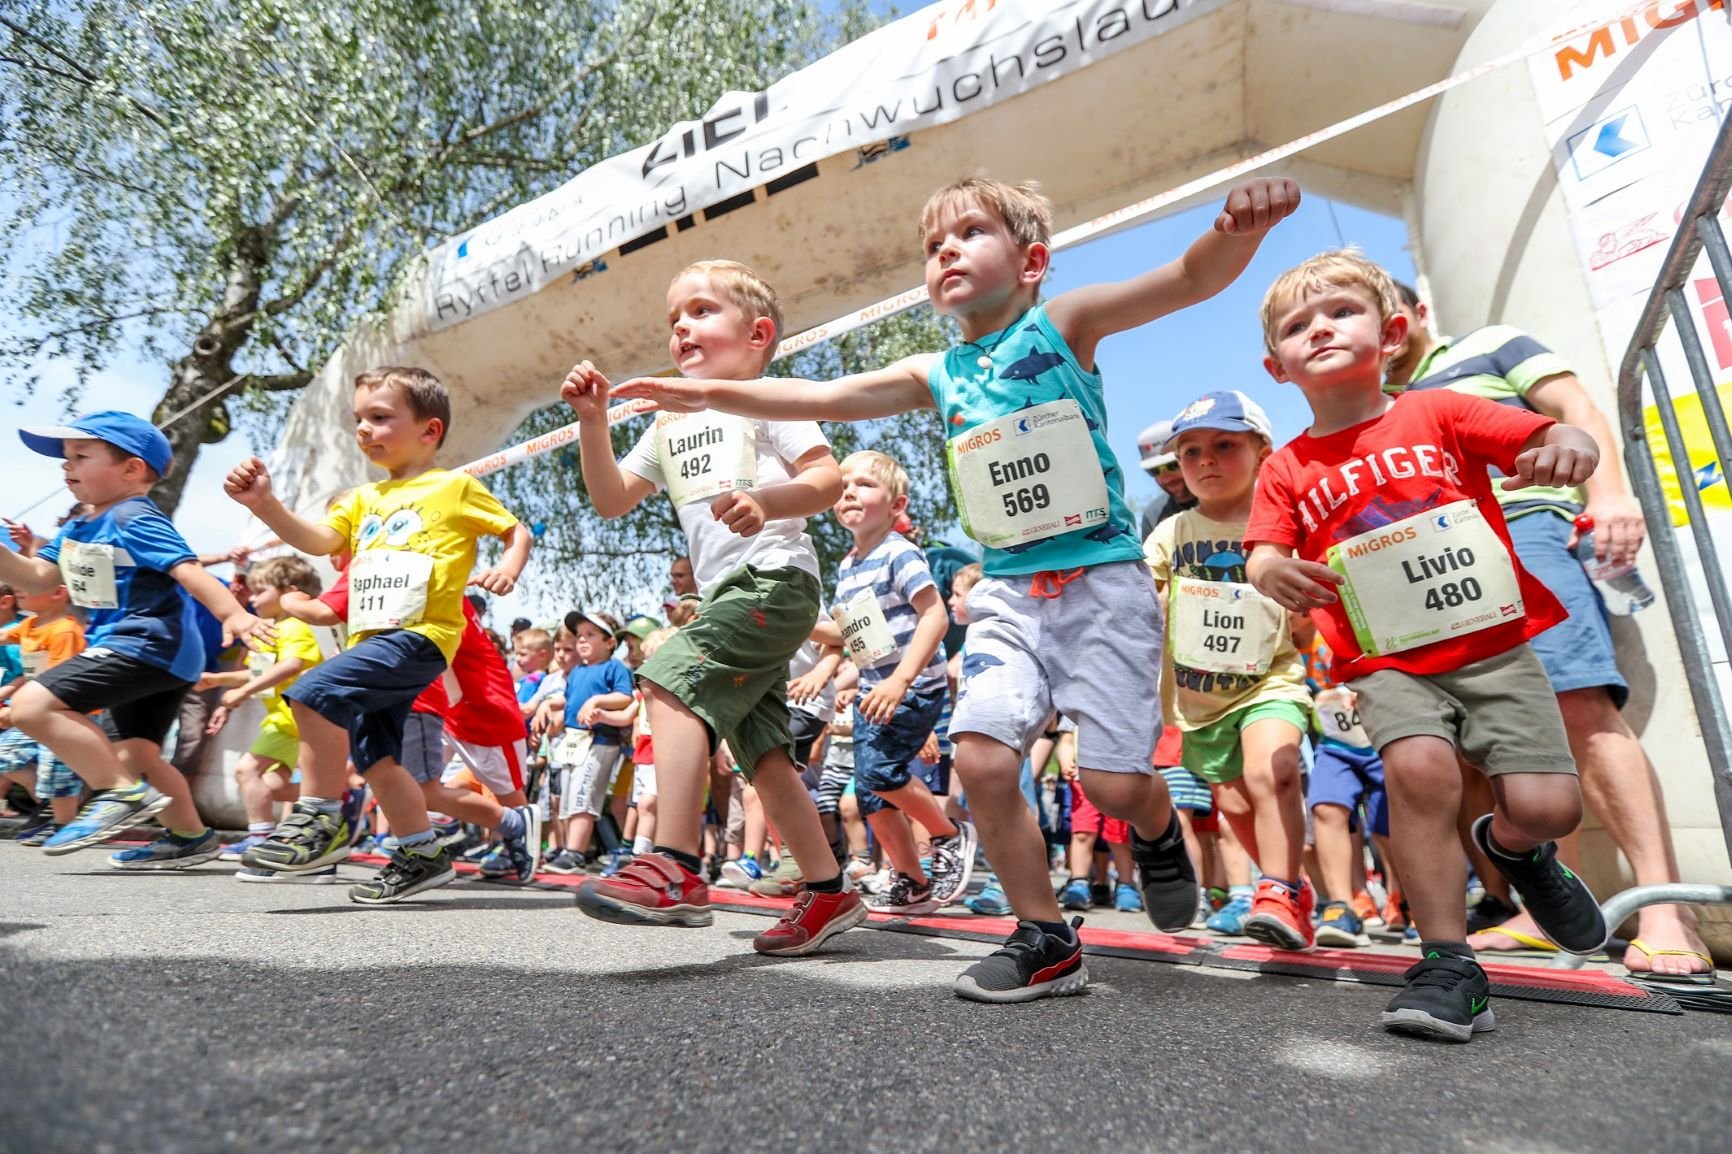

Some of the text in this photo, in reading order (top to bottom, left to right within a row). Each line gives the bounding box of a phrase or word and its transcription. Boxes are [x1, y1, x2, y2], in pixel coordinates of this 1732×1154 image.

[1554, 0, 1726, 82] MIG
[540, 186, 687, 274] Running
[526, 427, 575, 455] MIGROS
[777, 326, 829, 354] IGROS
[668, 426, 724, 457] Laurin
[957, 428, 1002, 455] MIGROS
[681, 453, 712, 479] 492
[988, 452, 1051, 487] Enno
[1002, 483, 1051, 518] 569
[1347, 526, 1417, 559] MIGROS
[1401, 546, 1475, 584] Livio
[1180, 584, 1220, 598] MIGROS
[1425, 576, 1482, 611] 480
[1203, 609, 1245, 630] Lion
[1203, 634, 1242, 653] 497
